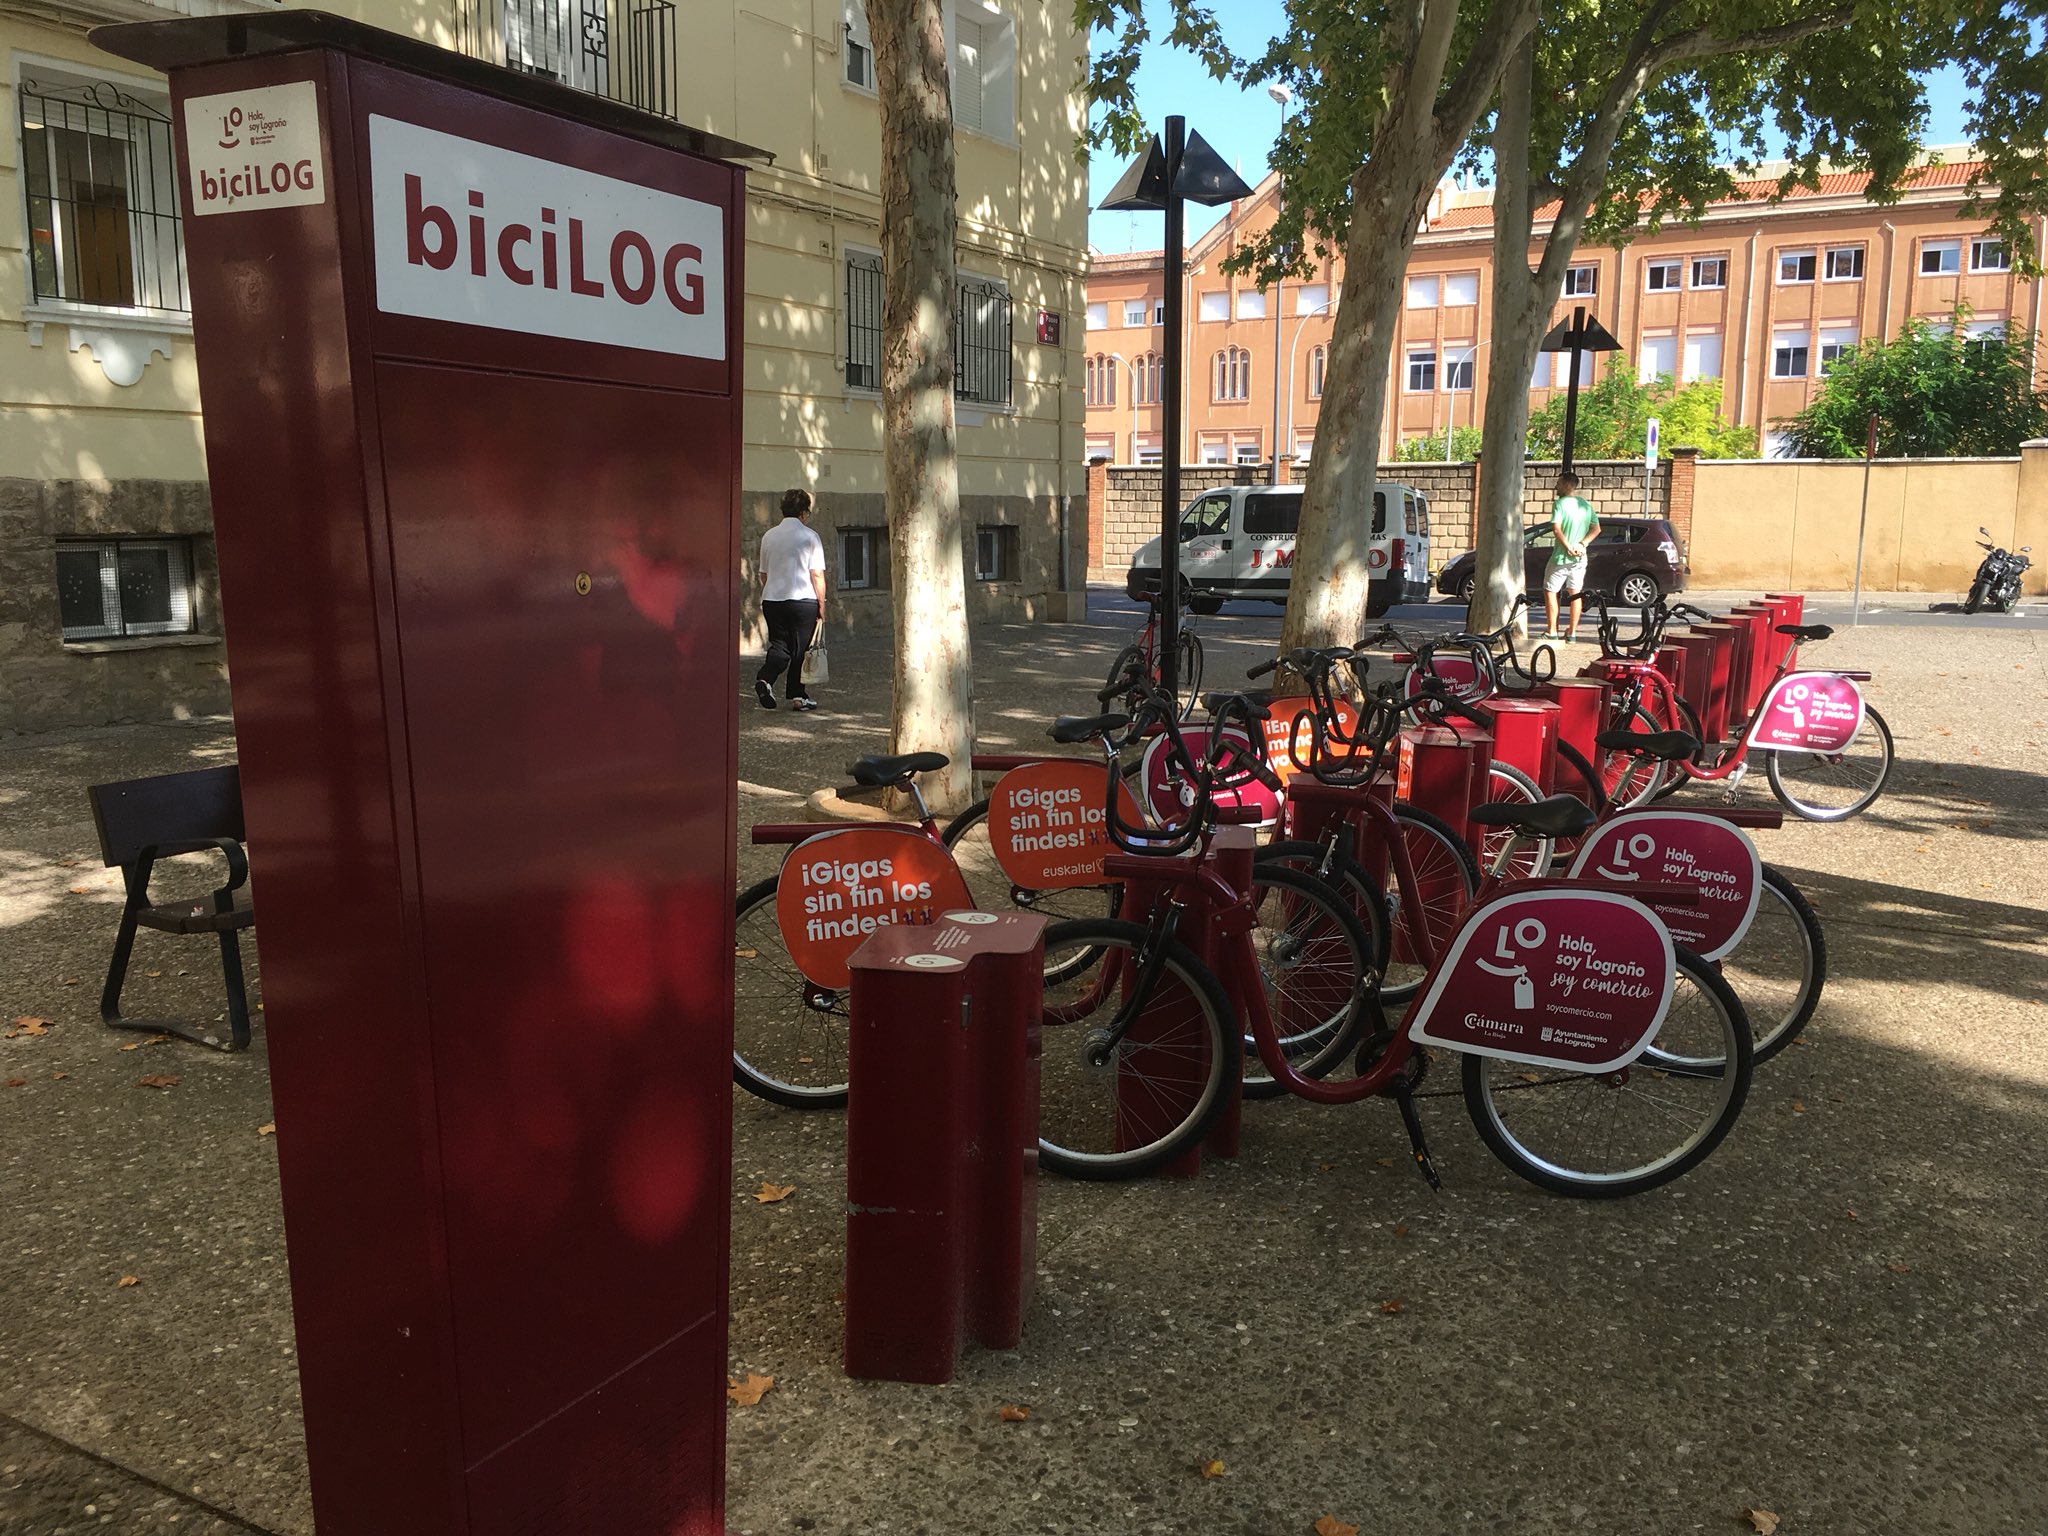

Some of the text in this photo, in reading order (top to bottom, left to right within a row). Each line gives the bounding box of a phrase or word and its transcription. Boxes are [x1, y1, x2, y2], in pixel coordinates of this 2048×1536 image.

[247, 110, 266, 121] Hola,
[249, 118, 287, 133] soy Logroño
[200, 159, 315, 201] biciLOG
[404, 173, 705, 315] biciLOG
[1251, 549, 1296, 569] J.M
[1455, 681, 1475, 690] Logro
[1009, 788, 1081, 810] ¡Gigas
[1010, 812, 1040, 830] sin
[1046, 808, 1073, 827] fin
[1011, 828, 1085, 852] findes!
[1665, 847, 1697, 865] Hola,
[802, 858, 894, 887] ¡Gigas
[1043, 862, 1095, 877] euskaltel
[1663, 862, 1737, 884] soy Logroño
[804, 881, 932, 914] sin fin los
[1699, 885, 1744, 902] mercio
[1655, 904, 1710, 920] soycomercio.com
[1668, 928, 1706, 939] untamiento
[1559, 934, 1597, 956] Hola,
[1556, 954, 1645, 977] soy Logroño
[1550, 972, 1654, 998] soy comercio
[1546, 1004, 1613, 1020] soycomercio.com
[1464, 1013, 1524, 1034] Cámara
[1554, 1029, 1608, 1043] Ayuntamiento
[1564, 1038, 1596, 1049] Logroño
